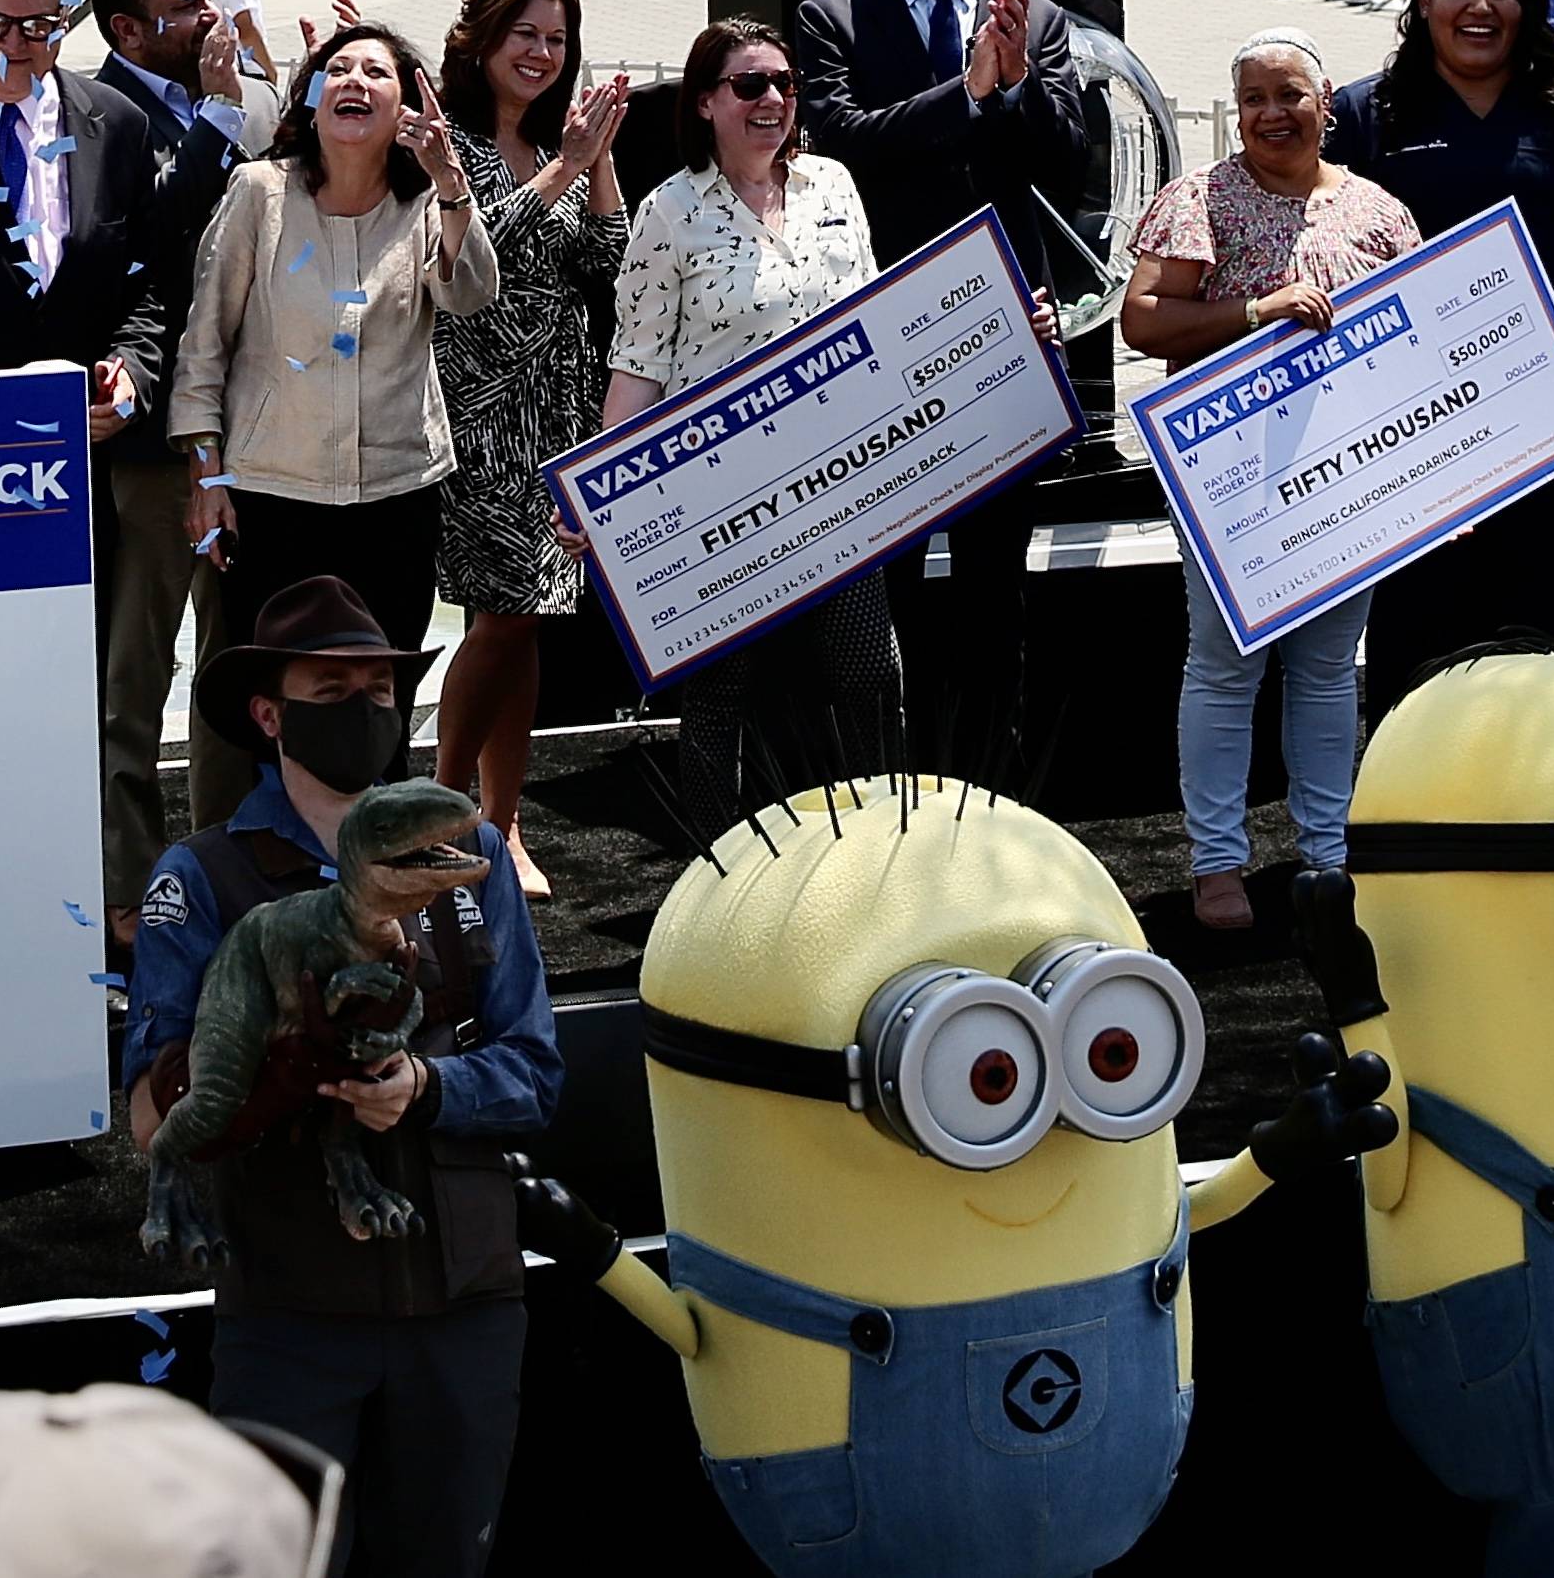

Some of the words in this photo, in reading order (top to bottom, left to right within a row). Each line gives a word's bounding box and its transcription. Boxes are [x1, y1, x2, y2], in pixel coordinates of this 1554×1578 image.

[901, 313, 931, 337] DATE
[940, 274, 986, 310] 6/11/21
[1435, 296, 1462, 316] DATE
[1469, 267, 1509, 298] 6/11/21
[913, 334, 983, 387] $50,000
[1449, 324, 1509, 367] $50,000
[1505, 352, 1548, 382] DOLLARS
[976, 355, 1027, 393] DOLLARS
[1172, 395, 1237, 441] VAX
[1233, 367, 1293, 412] FOR
[1291, 336, 1346, 379] THE
[1344, 305, 1404, 349] WIN
[586, 449, 659, 498] VAX
[660, 414, 729, 463] FOR
[728, 374, 794, 423] THE
[794, 333, 863, 384] WIN
[929, 489, 954, 507] Check
[954, 479, 966, 491] for
[966, 463, 994, 484] Display
[994, 440, 1030, 465] Purposes
[1029, 427, 1048, 443] Only
[1203, 476, 1225, 492] PAY
[1225, 466, 1241, 481] TO
[1240, 453, 1263, 471] THE
[1208, 478, 1246, 502] ORDER
[1246, 468, 1261, 483] OF
[1225, 506, 1270, 538] AMOUNT
[1277, 453, 1344, 506] FIFTY
[1347, 380, 1480, 465] THOUSAND
[636, 557, 689, 591] AMOUNT
[699, 493, 780, 554] FIFTY
[785, 398, 946, 504] THOUSAND
[1242, 556, 1266, 573] FOR
[1281, 513, 1339, 552] BRINGING
[1340, 474, 1409, 518] CALIFORNIA
[1408, 444, 1461, 480] ROARING
[1460, 425, 1494, 452] BACK
[615, 529, 639, 548] PAY
[640, 518, 659, 534] TO
[659, 505, 685, 522] THE
[620, 530, 664, 557] ORDER
[665, 519, 683, 534] OF
[652, 606, 678, 626] FOR
[698, 555, 769, 601] BRINGING
[770, 506, 855, 560] CALIFORNIA
[855, 467, 918, 512] ROARING
[918, 441, 958, 472] BACK
